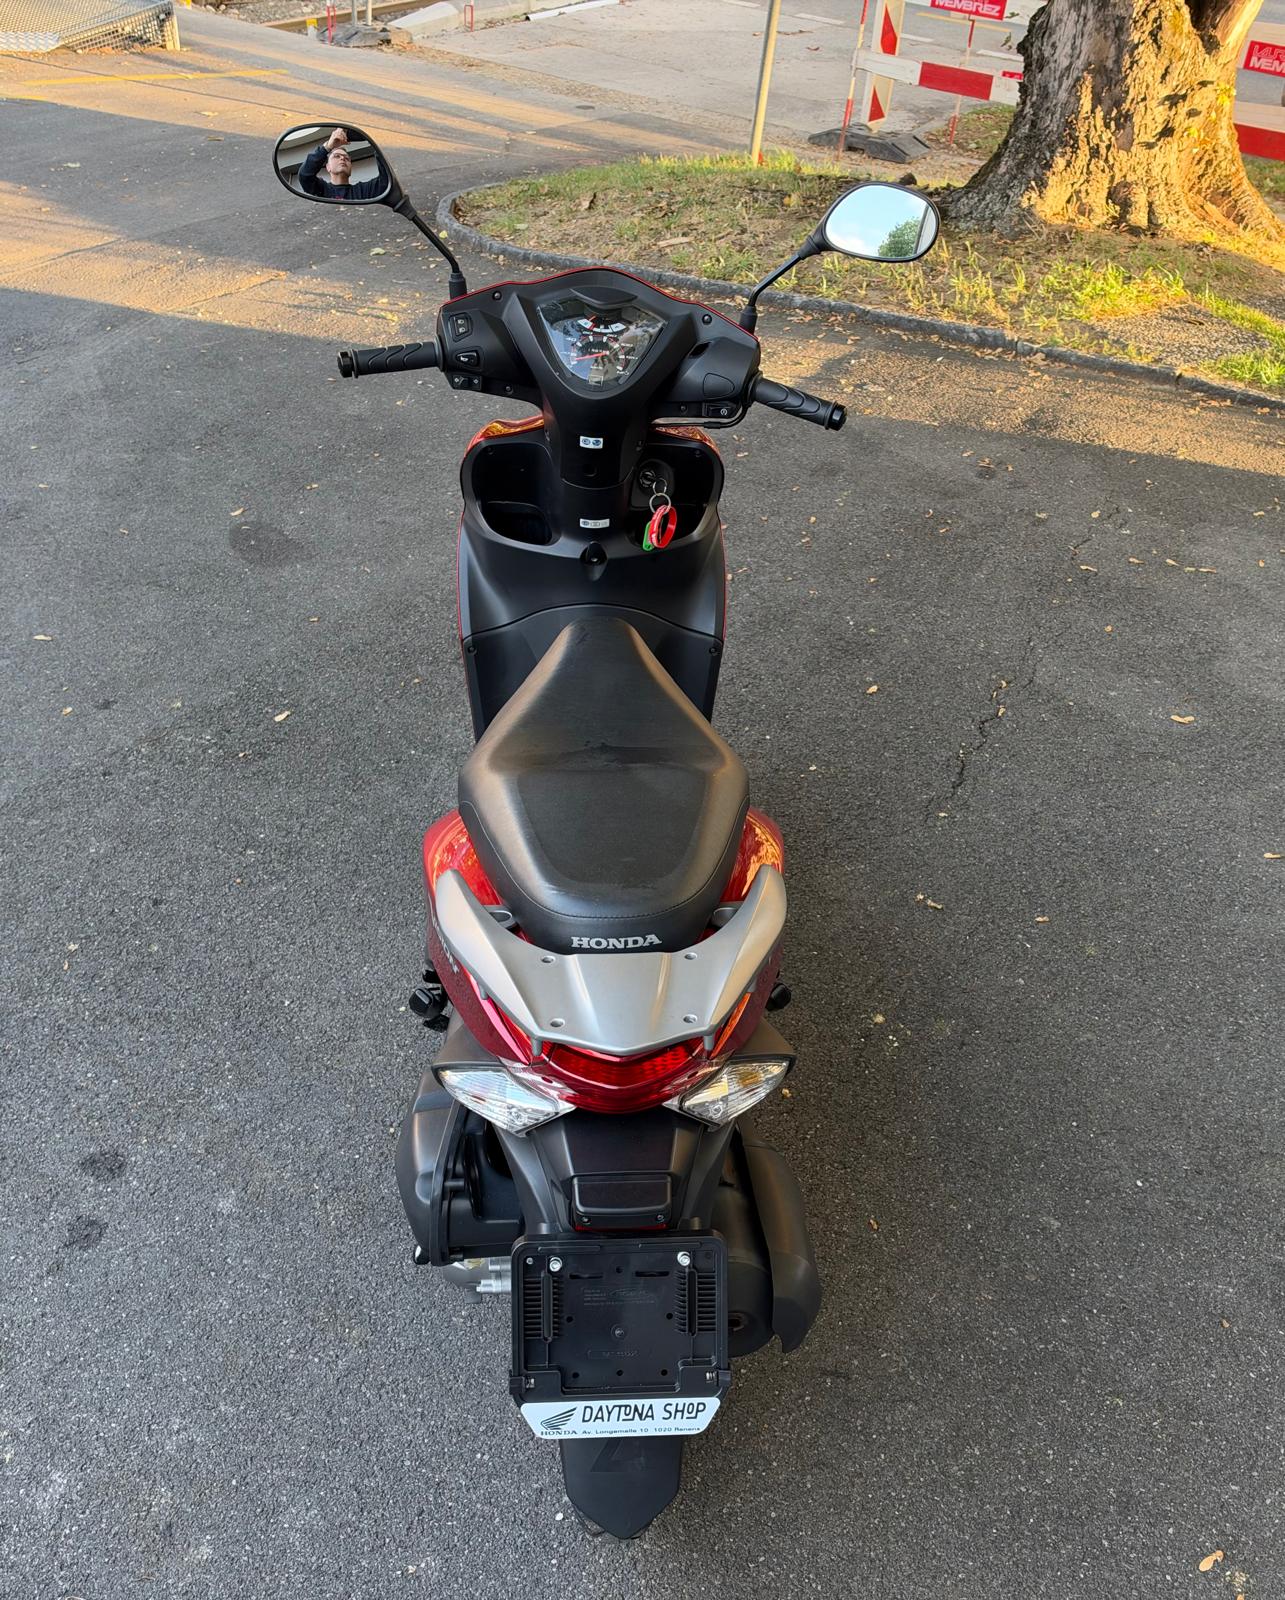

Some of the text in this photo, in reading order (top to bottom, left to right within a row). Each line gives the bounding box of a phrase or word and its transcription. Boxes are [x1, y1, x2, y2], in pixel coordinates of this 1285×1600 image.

[571, 934, 662, 949] HONDA
[582, 1402, 706, 1423] DAYTONA SHOP
